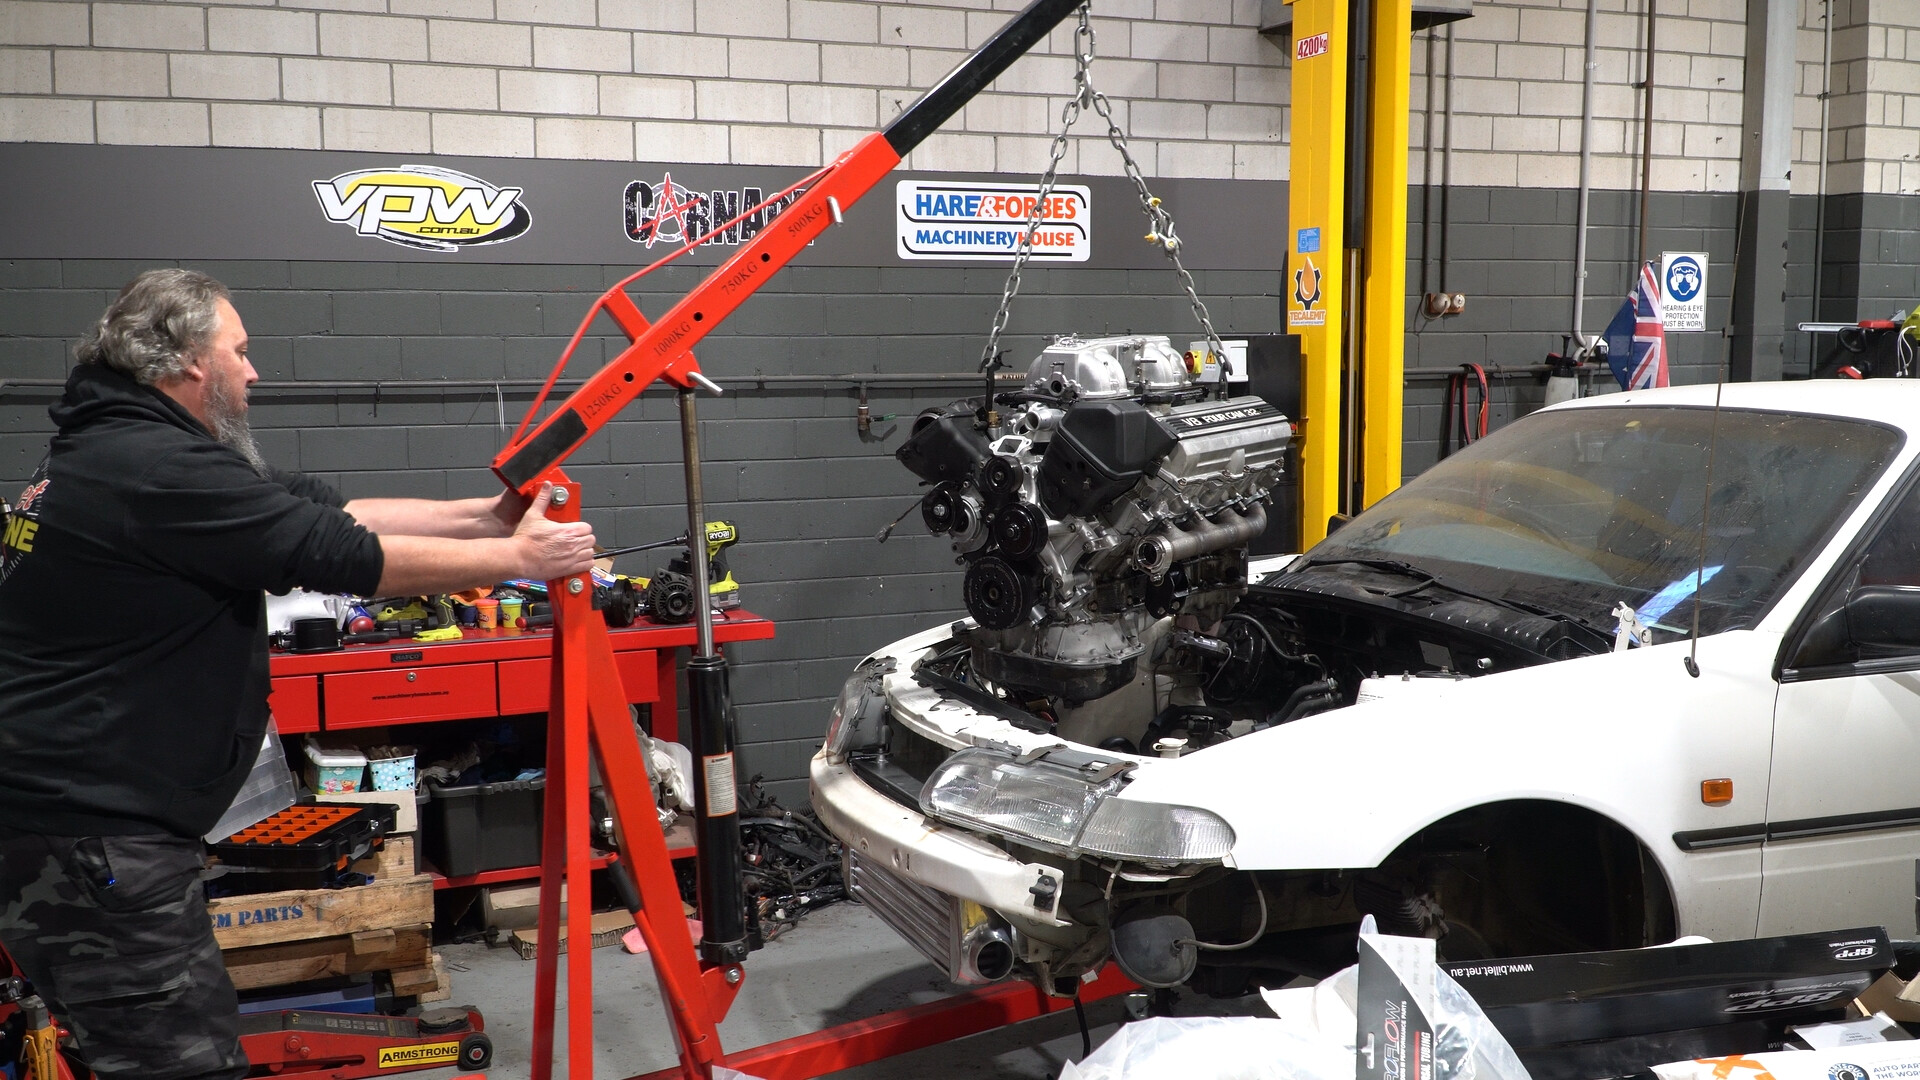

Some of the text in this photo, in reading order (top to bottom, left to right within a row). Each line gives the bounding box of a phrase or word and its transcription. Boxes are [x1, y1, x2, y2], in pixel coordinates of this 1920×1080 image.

[1298, 35, 1327, 57] 4200kg
[623, 172, 814, 254] CARNA
[788, 203, 823, 238] 500KG
[416, 226, 480, 235] .com.au
[721, 261, 758, 295] 750KG
[1290, 310, 1325, 321] TECALEMIT
[653, 321, 692, 356] 1000KG
[582, 383, 622, 419] 1250KG
[708, 531, 730, 540] RYOBI
[238, 904, 304, 926] PARTS
[1835, 947, 1873, 958] BPP
[1450, 963, 1534, 978] www.billet.net.au
[1724, 990, 1843, 1012] BPP
[381, 1045, 458, 1063] ARMSTRONG
[1421, 1032, 1431, 1062] TUBING
[1874, 1065, 1898, 1073] AUTO
[1876, 1070, 1920, 1080] THE WOR
